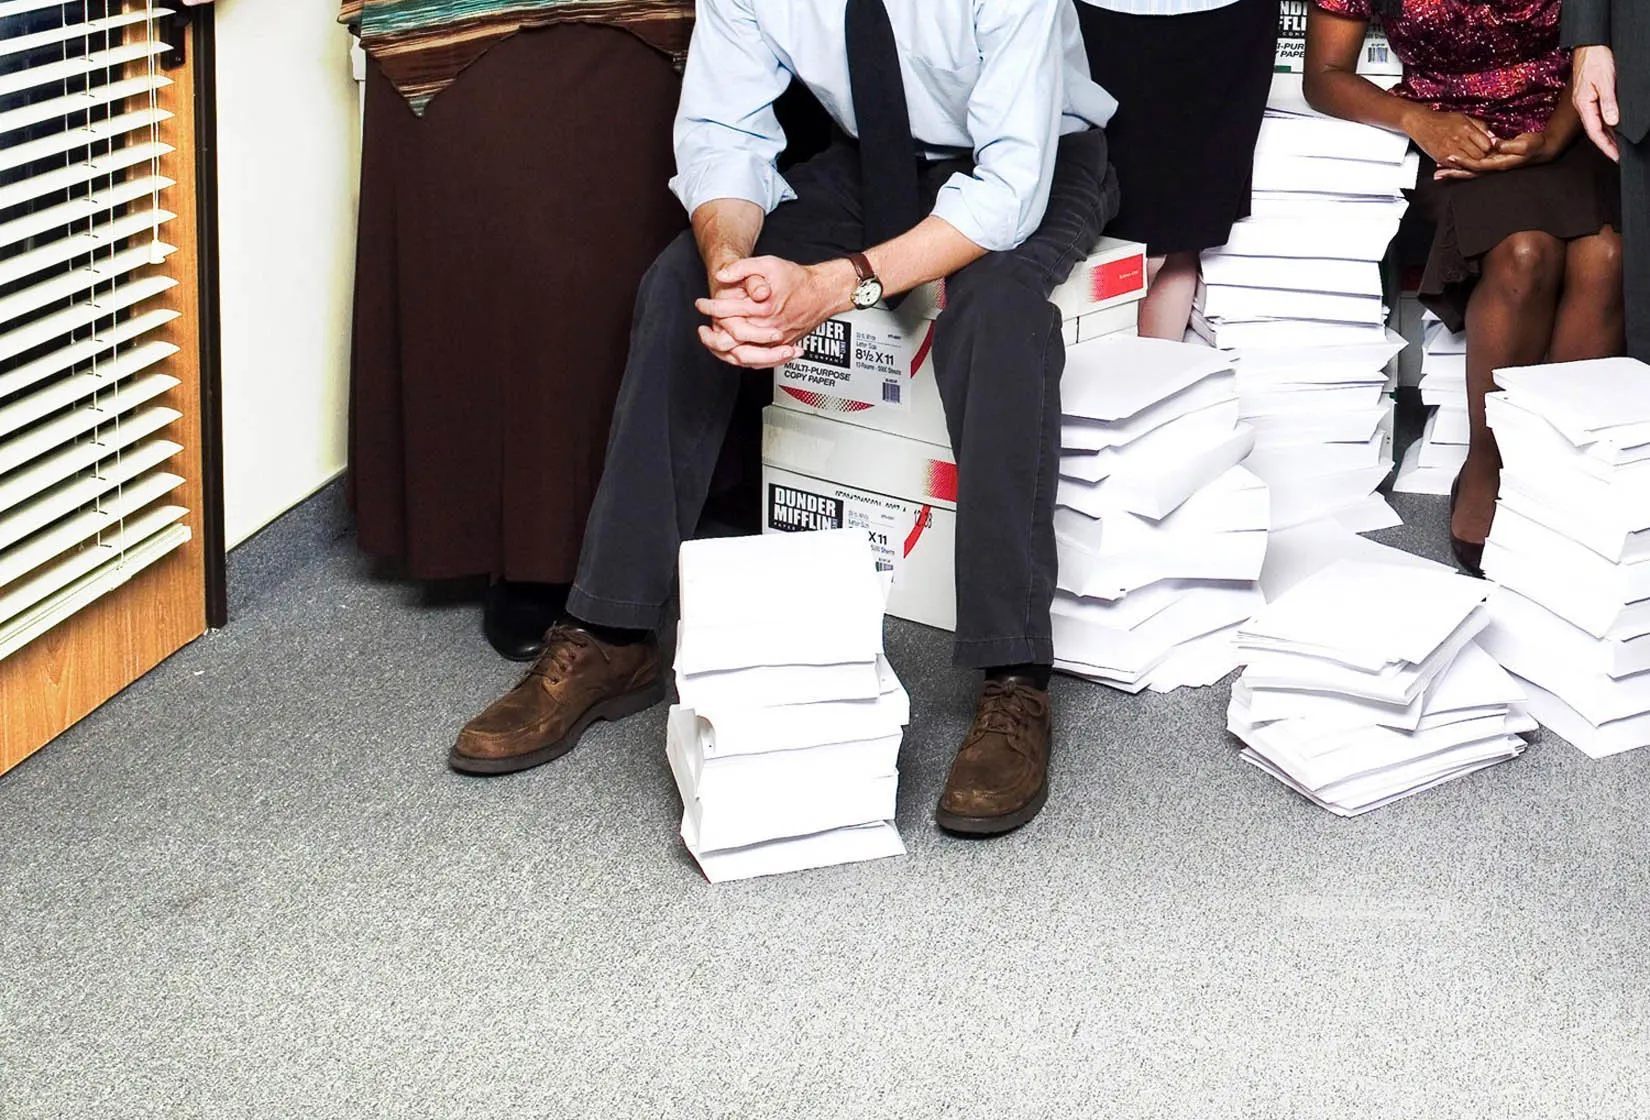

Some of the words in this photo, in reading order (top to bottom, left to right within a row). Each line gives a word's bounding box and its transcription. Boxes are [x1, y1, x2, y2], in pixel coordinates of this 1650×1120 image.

[815, 321, 844, 340] DER
[856, 349, 874, 362] 8½
[875, 351, 884, 364] X
[885, 354, 894, 366] 11
[784, 362, 851, 382] MULTI-PURPOSE
[784, 369, 807, 382] COPY
[808, 374, 836, 388] PAPER
[774, 487, 836, 518] DUNDER
[868, 530, 877, 543] X
[879, 533, 888, 545] 11
